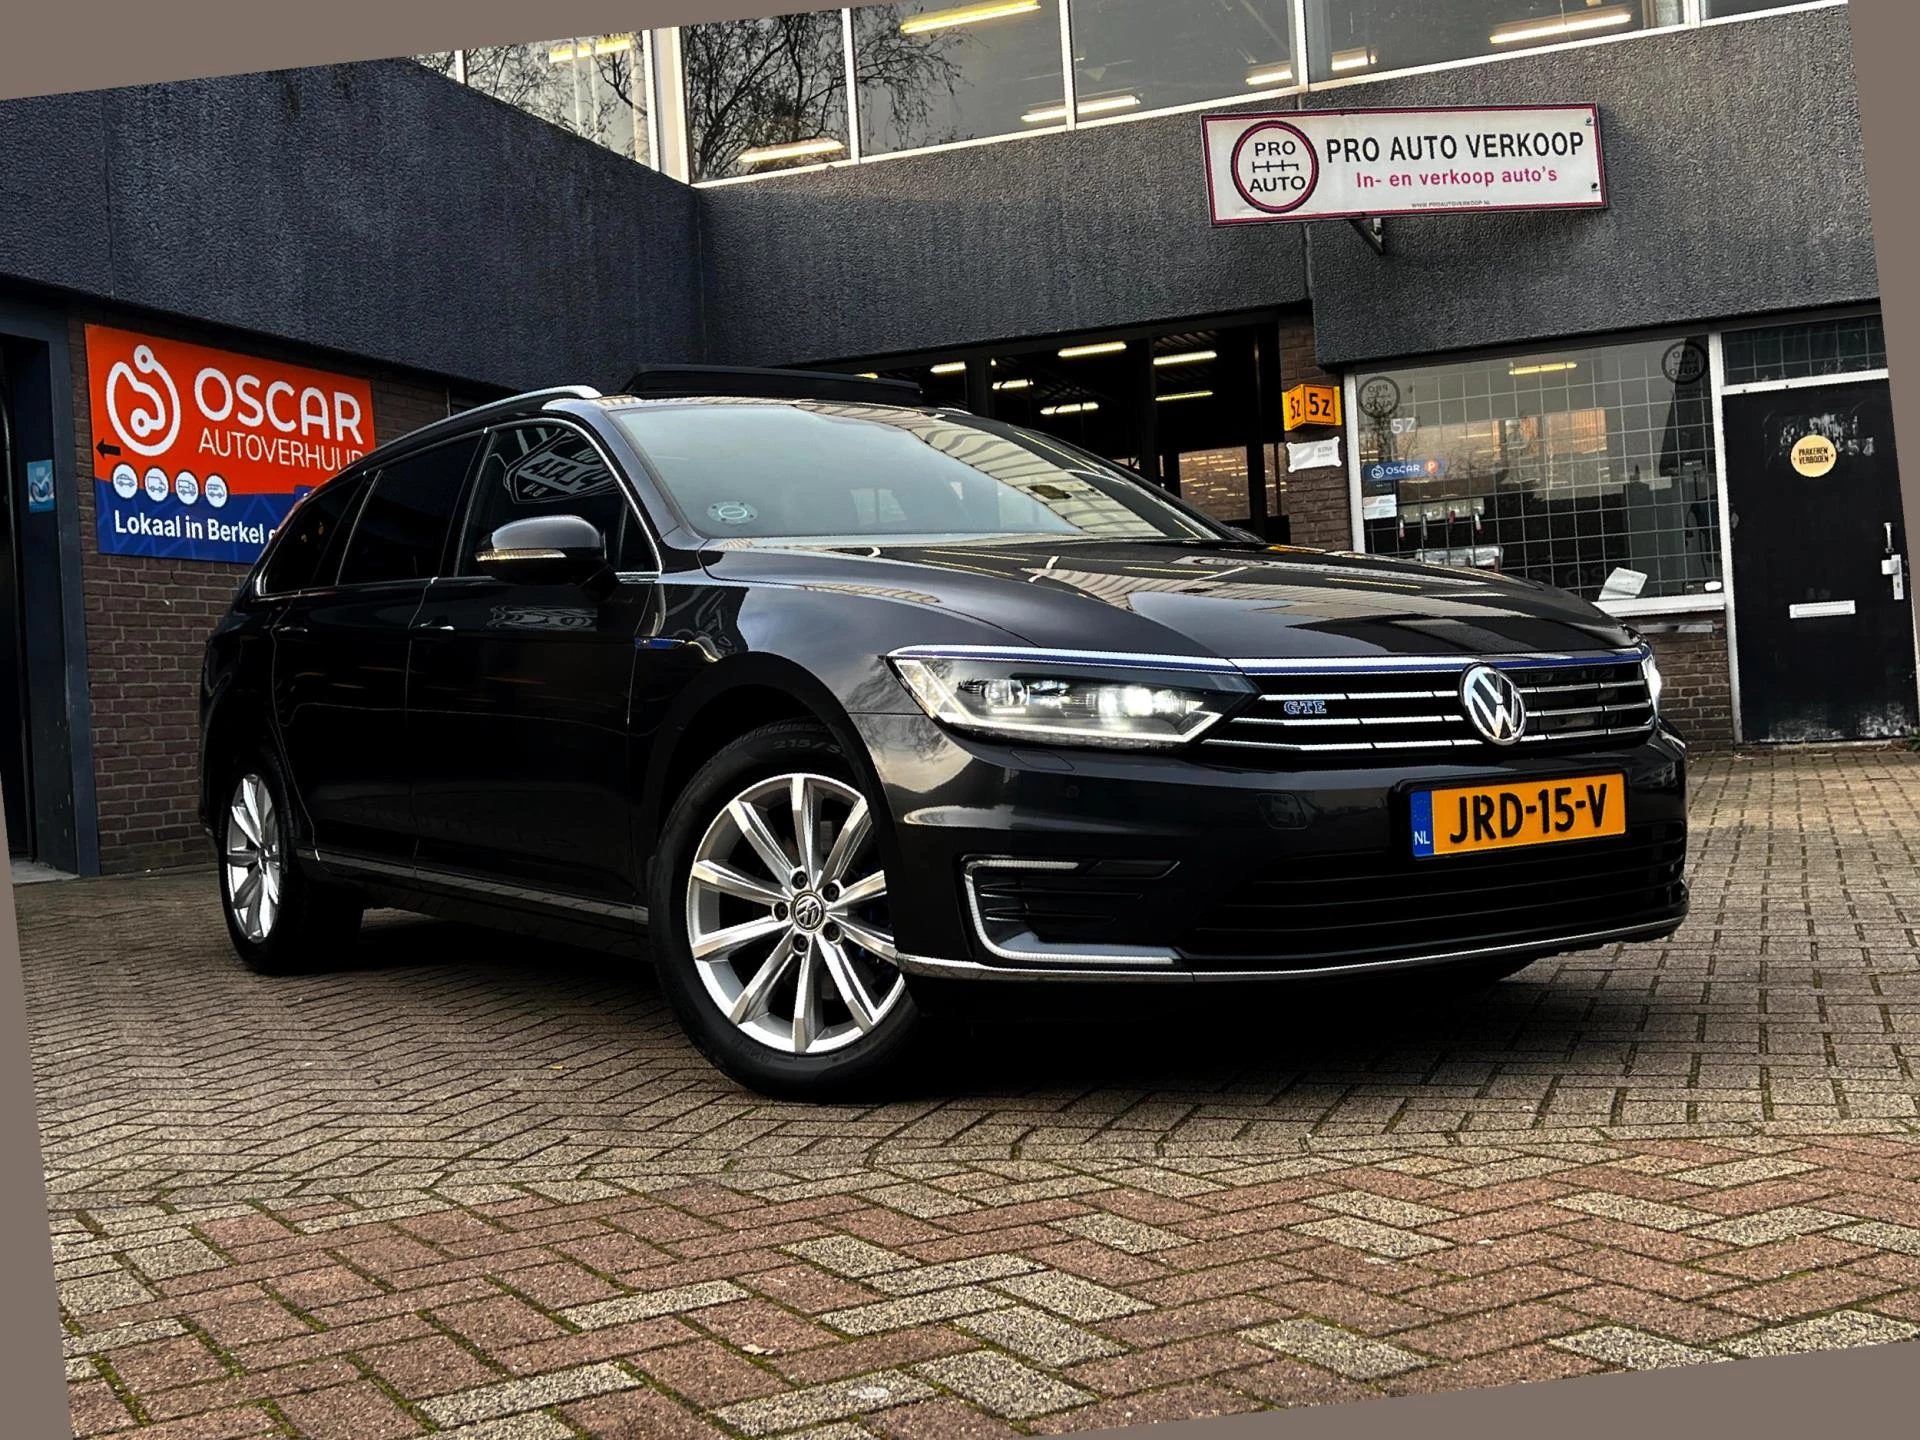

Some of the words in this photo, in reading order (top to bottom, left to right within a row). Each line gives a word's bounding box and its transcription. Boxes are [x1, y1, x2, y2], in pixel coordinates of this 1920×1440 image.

[1254, 140, 1296, 157] PRO
[1326, 137, 1380, 163] PRO
[1390, 134, 1457, 161] AUTO
[1465, 131, 1584, 158] VERKOOP
[1249, 175, 1306, 193] AUTO
[1356, 172, 1382, 188] In-
[1389, 174, 1412, 187] en
[1419, 169, 1494, 187] verkoop
[1502, 166, 1558, 183] auto's
[194, 367, 364, 445] OSCAR
[1386, 464, 1420, 475] OSCAR
[115, 510, 181, 538] Lokaal
[185, 515, 203, 539] in
[207, 518, 264, 544] Berkel
[1283, 700, 1327, 715] GTE
[1449, 783, 1608, 845] JRD-15-V
[1414, 831, 1431, 846] NL
